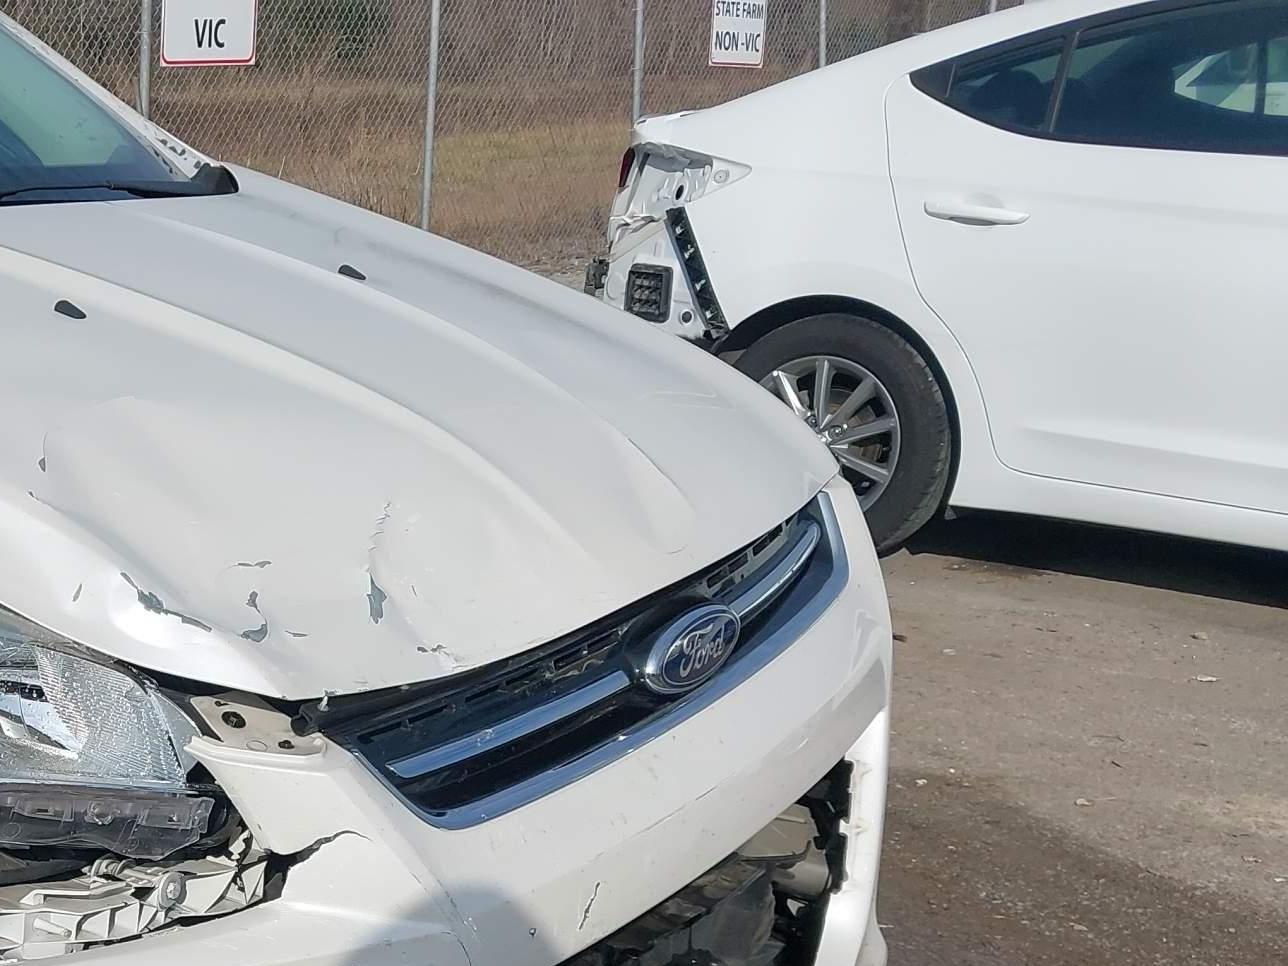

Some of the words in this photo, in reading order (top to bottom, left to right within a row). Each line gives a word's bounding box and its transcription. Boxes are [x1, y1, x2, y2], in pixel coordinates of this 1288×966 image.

[715, 1, 740, 18] STATE
[742, 2, 764, 20] FARM
[194, 18, 226, 49] VIC
[679, 622, 726, 678] Ford
